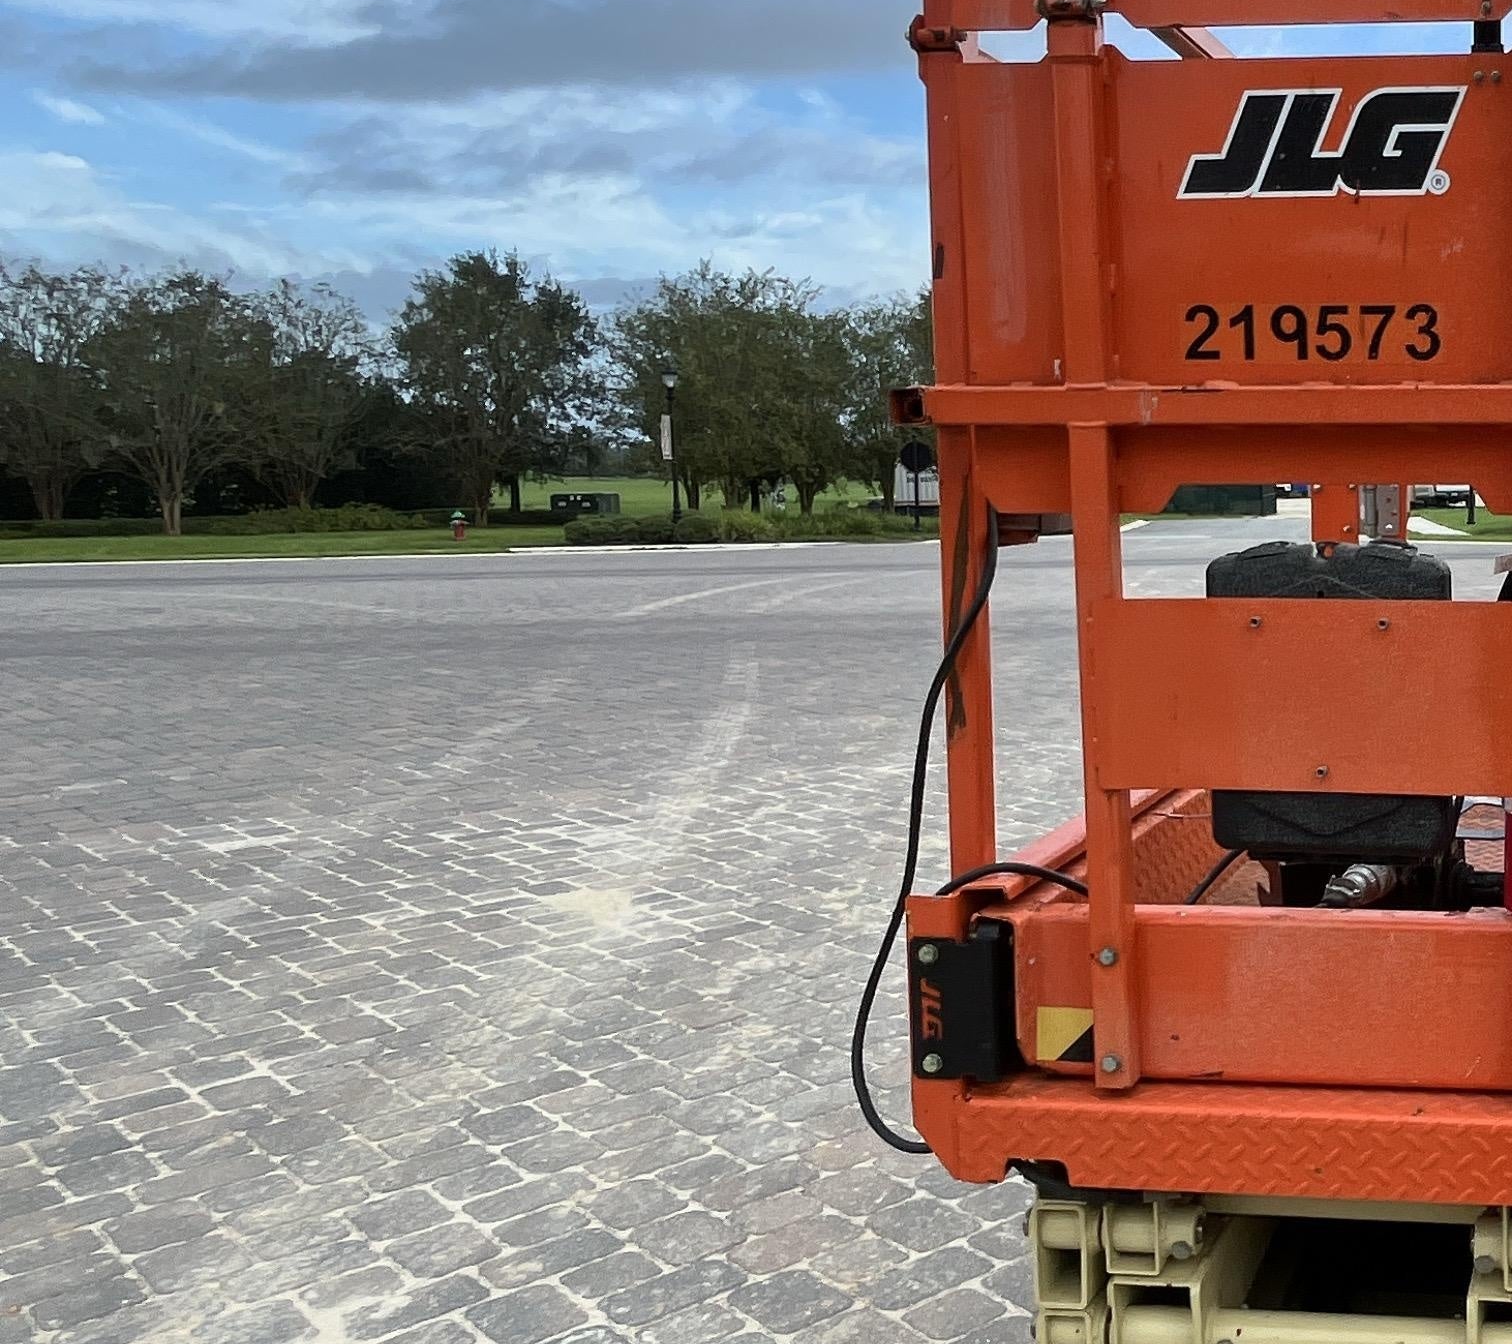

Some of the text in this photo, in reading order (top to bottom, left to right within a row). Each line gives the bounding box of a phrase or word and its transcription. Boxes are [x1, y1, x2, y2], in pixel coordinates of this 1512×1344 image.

[1176, 84, 1468, 200] JLG
[1184, 303, 1442, 362] 219573
[919, 976, 943, 1040] JLG
